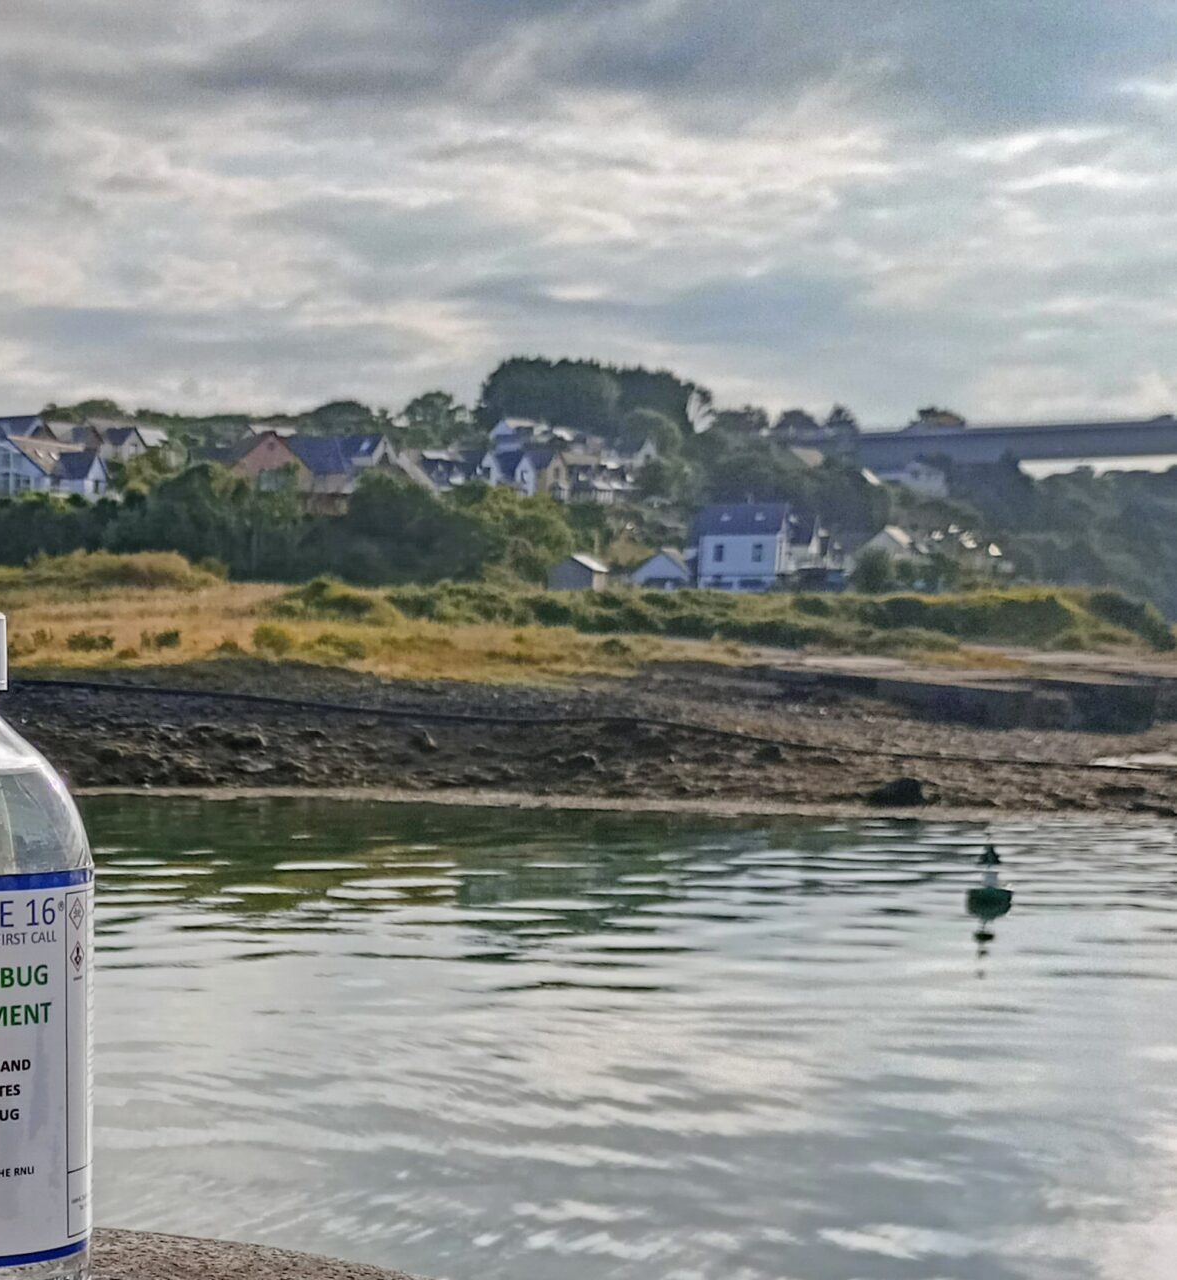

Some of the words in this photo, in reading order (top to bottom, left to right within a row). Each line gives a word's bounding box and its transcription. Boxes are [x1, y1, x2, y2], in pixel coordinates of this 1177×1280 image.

[30, 930, 57, 943] CALL
[0, 964, 49, 989] BUG
[0, 1059, 31, 1073] AND
[13, 1166, 35, 1177] RNLI
